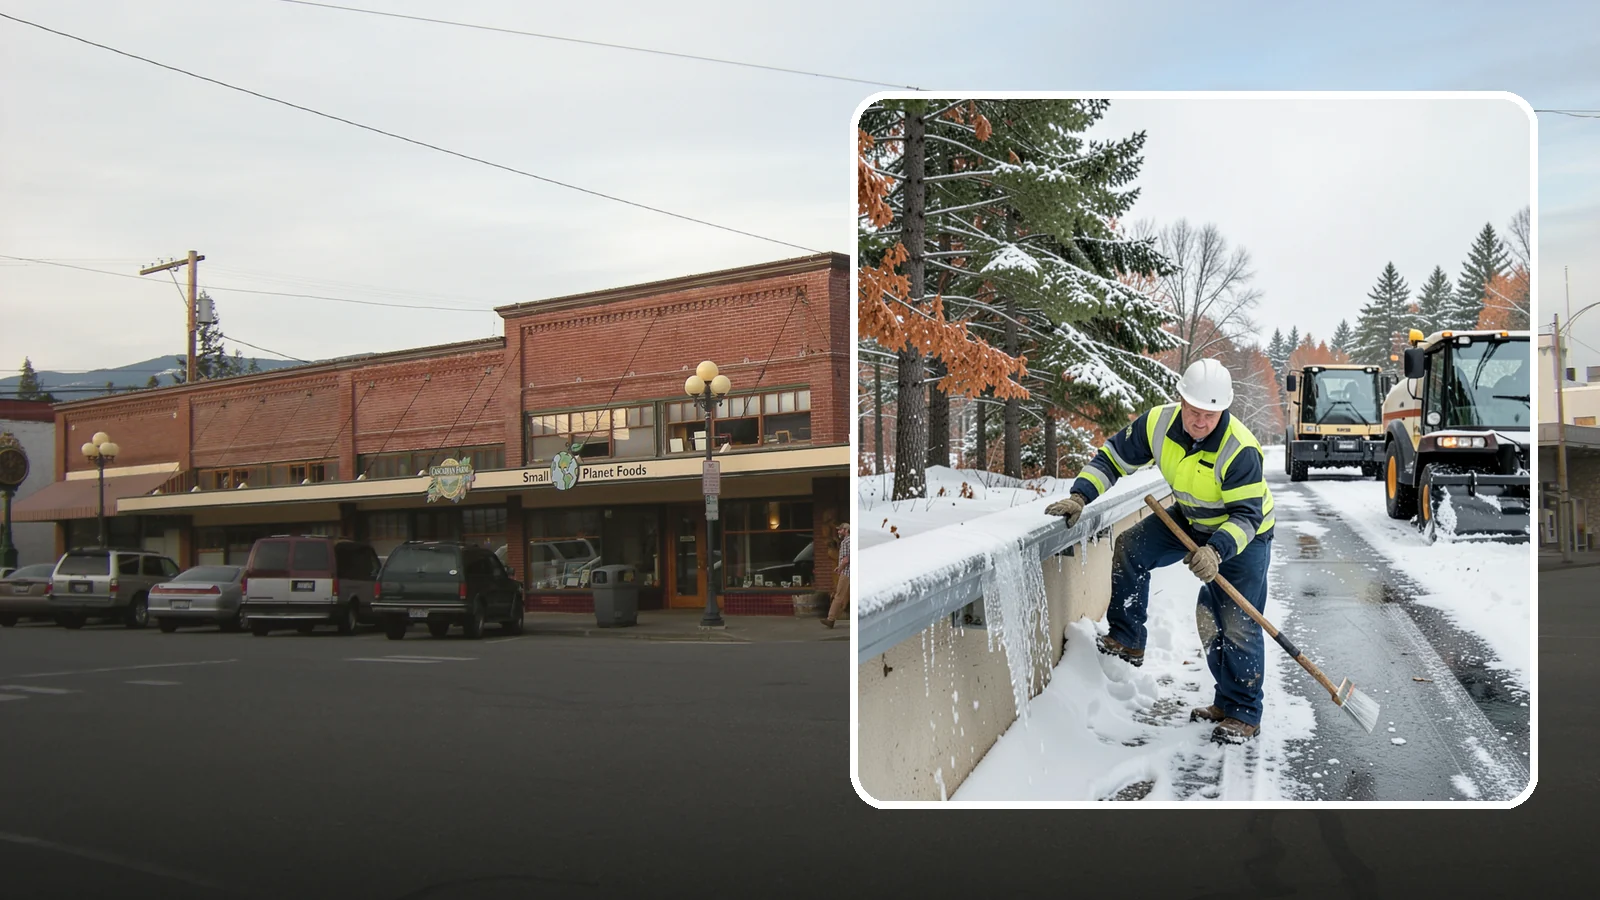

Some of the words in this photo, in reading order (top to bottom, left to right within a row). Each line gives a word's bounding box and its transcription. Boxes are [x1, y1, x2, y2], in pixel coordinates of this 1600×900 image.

[523, 471, 549, 483] Small
[583, 467, 614, 479] Planet
[617, 464, 647, 477] Foods
